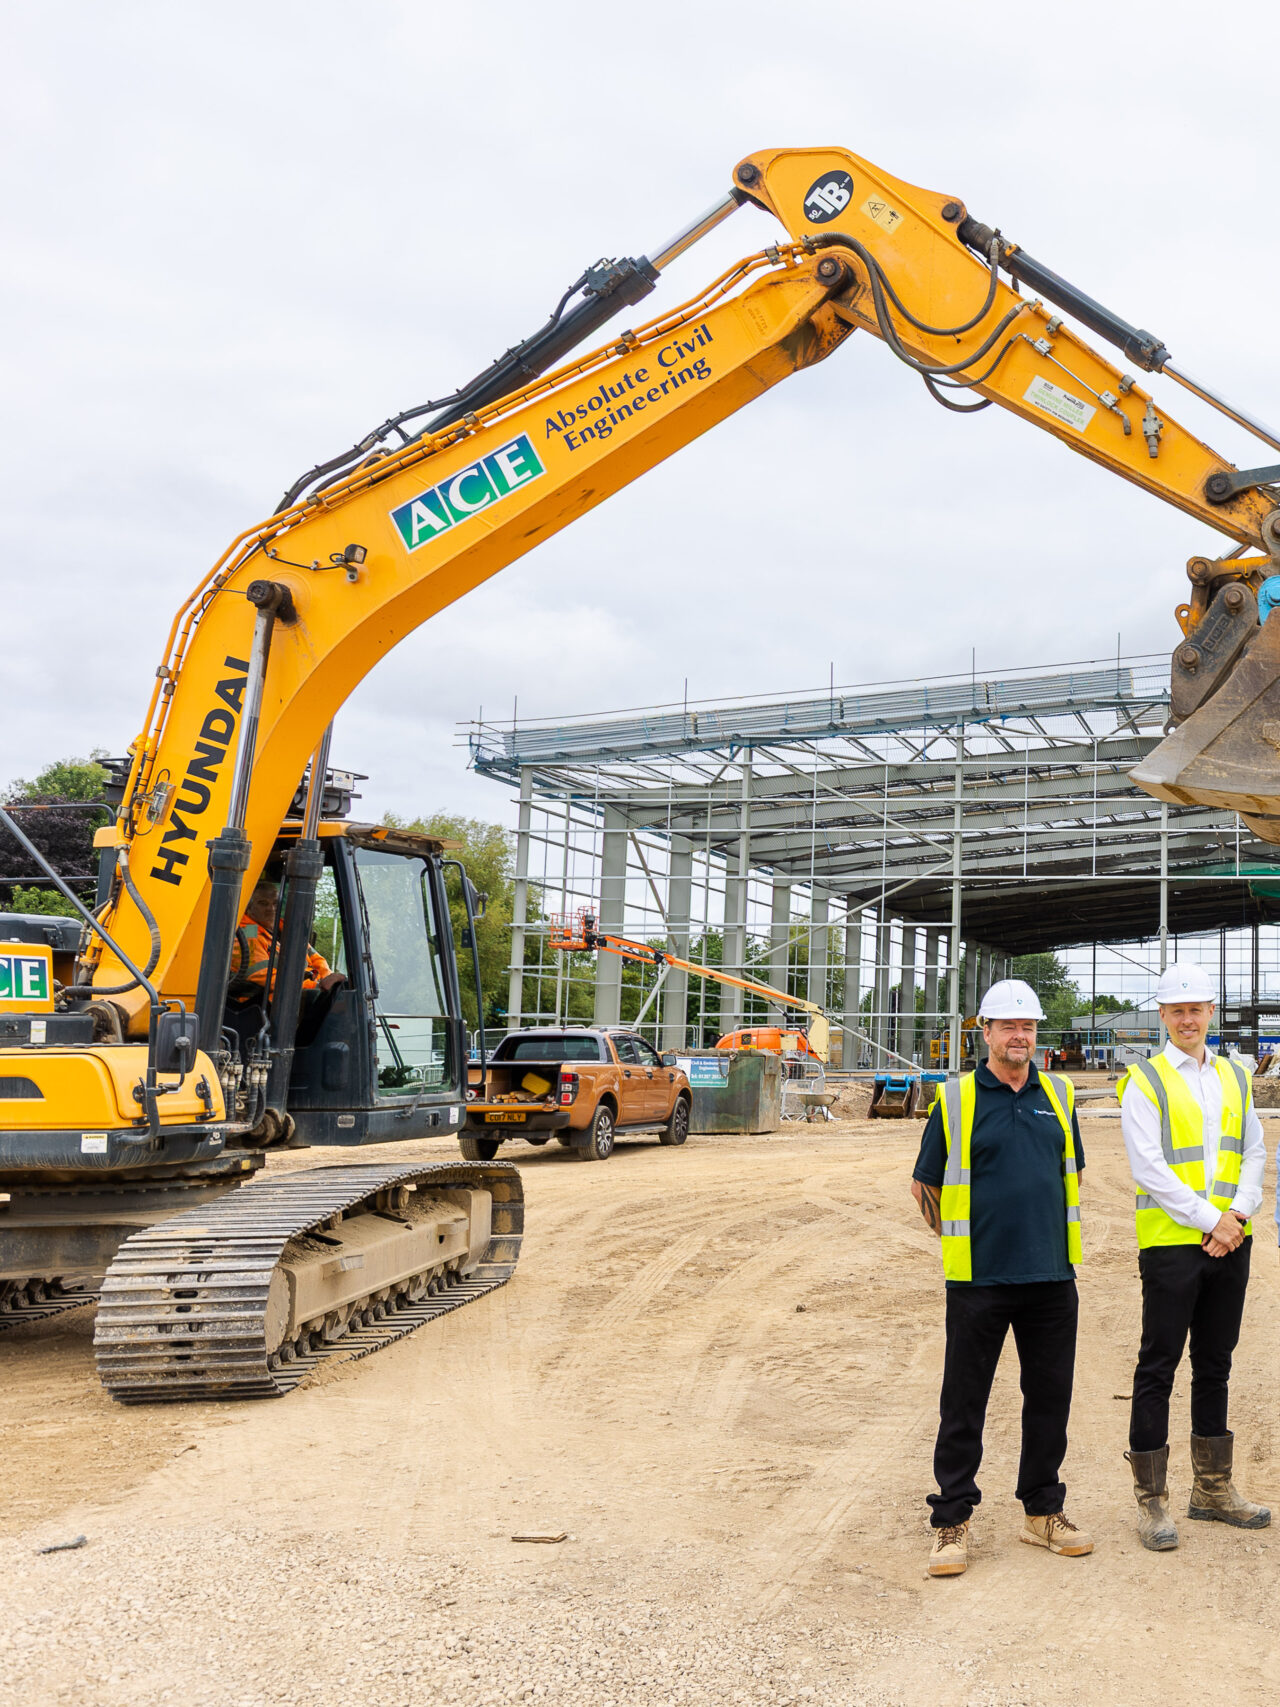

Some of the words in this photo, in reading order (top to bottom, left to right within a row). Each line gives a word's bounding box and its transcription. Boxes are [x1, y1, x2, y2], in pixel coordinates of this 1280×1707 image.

[804, 181, 850, 215] TB
[544, 367, 651, 440] Absolute
[656, 323, 715, 368] Civil
[562, 356, 713, 452] Engineering
[410, 442, 533, 546] ACE
[149, 655, 250, 887] HYUNDAI
